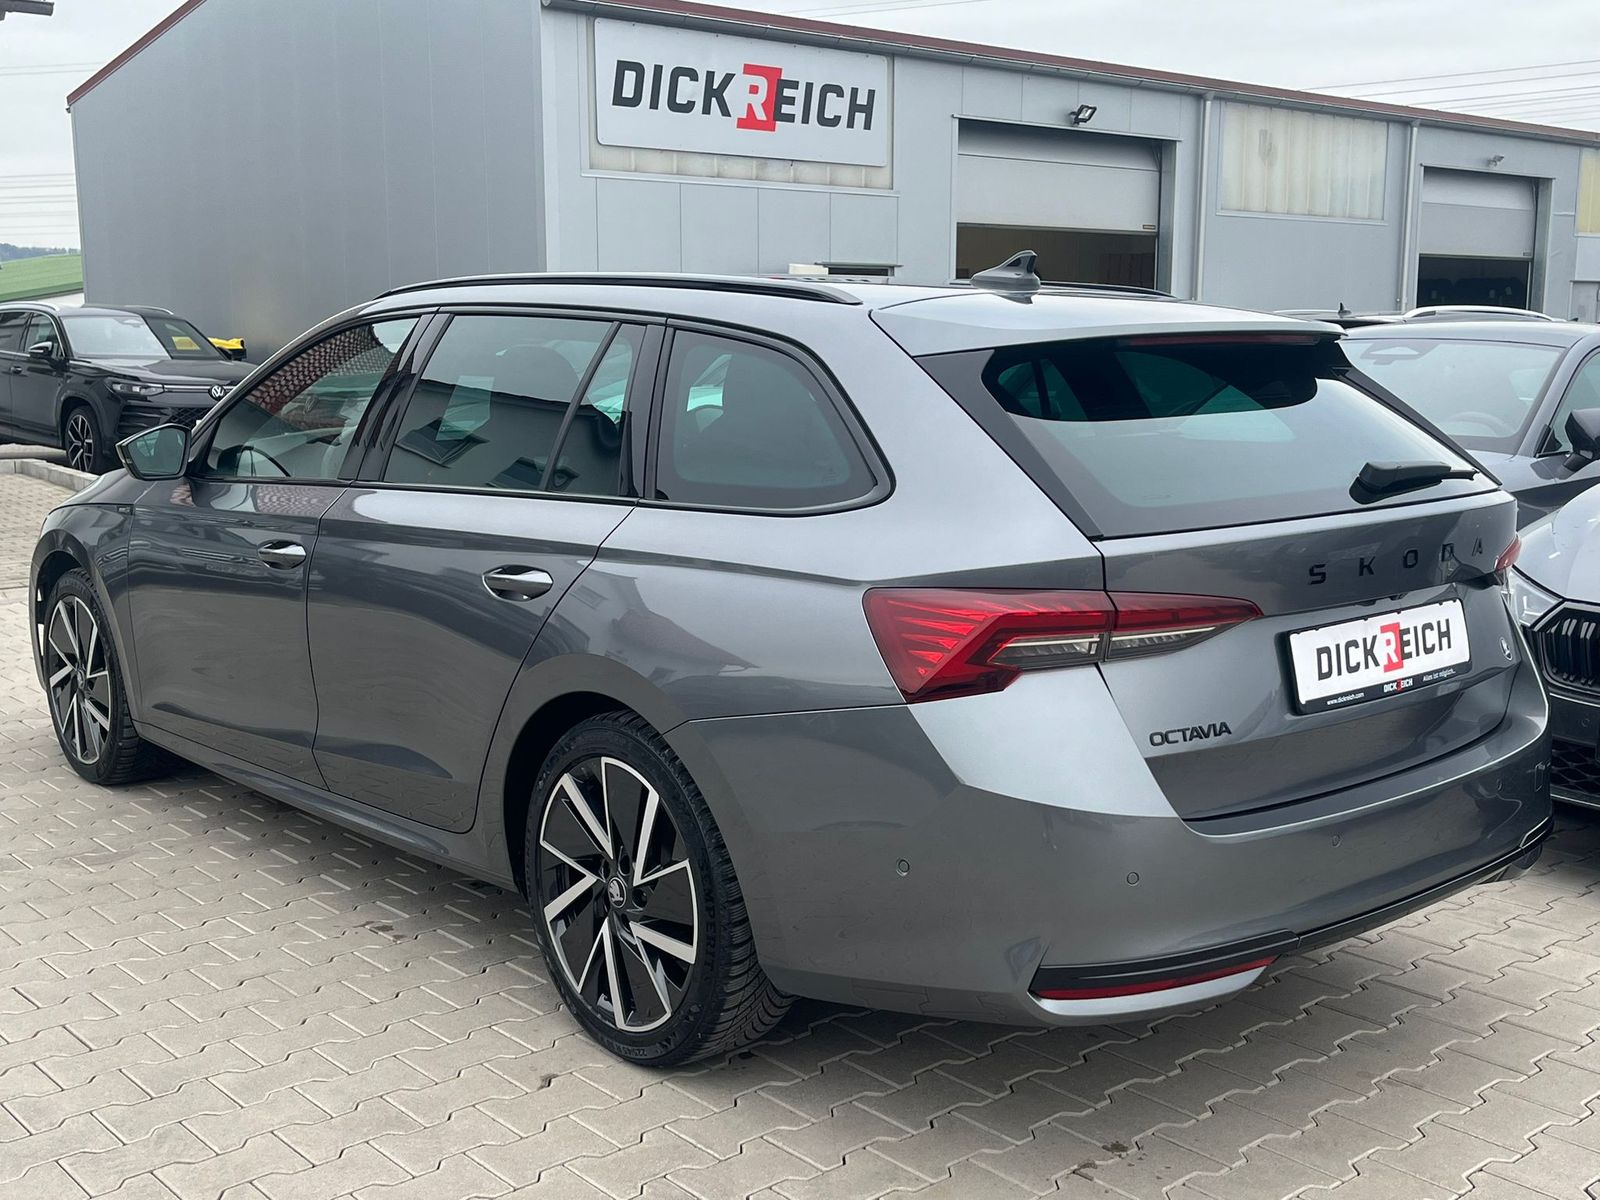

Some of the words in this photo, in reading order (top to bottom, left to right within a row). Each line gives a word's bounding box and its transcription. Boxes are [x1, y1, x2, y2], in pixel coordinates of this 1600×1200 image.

[611, 59, 876, 132] DICKREICH
[1315, 618, 1452, 681] DICKREICH
[1149, 721, 1232, 747] OCTAVIA
